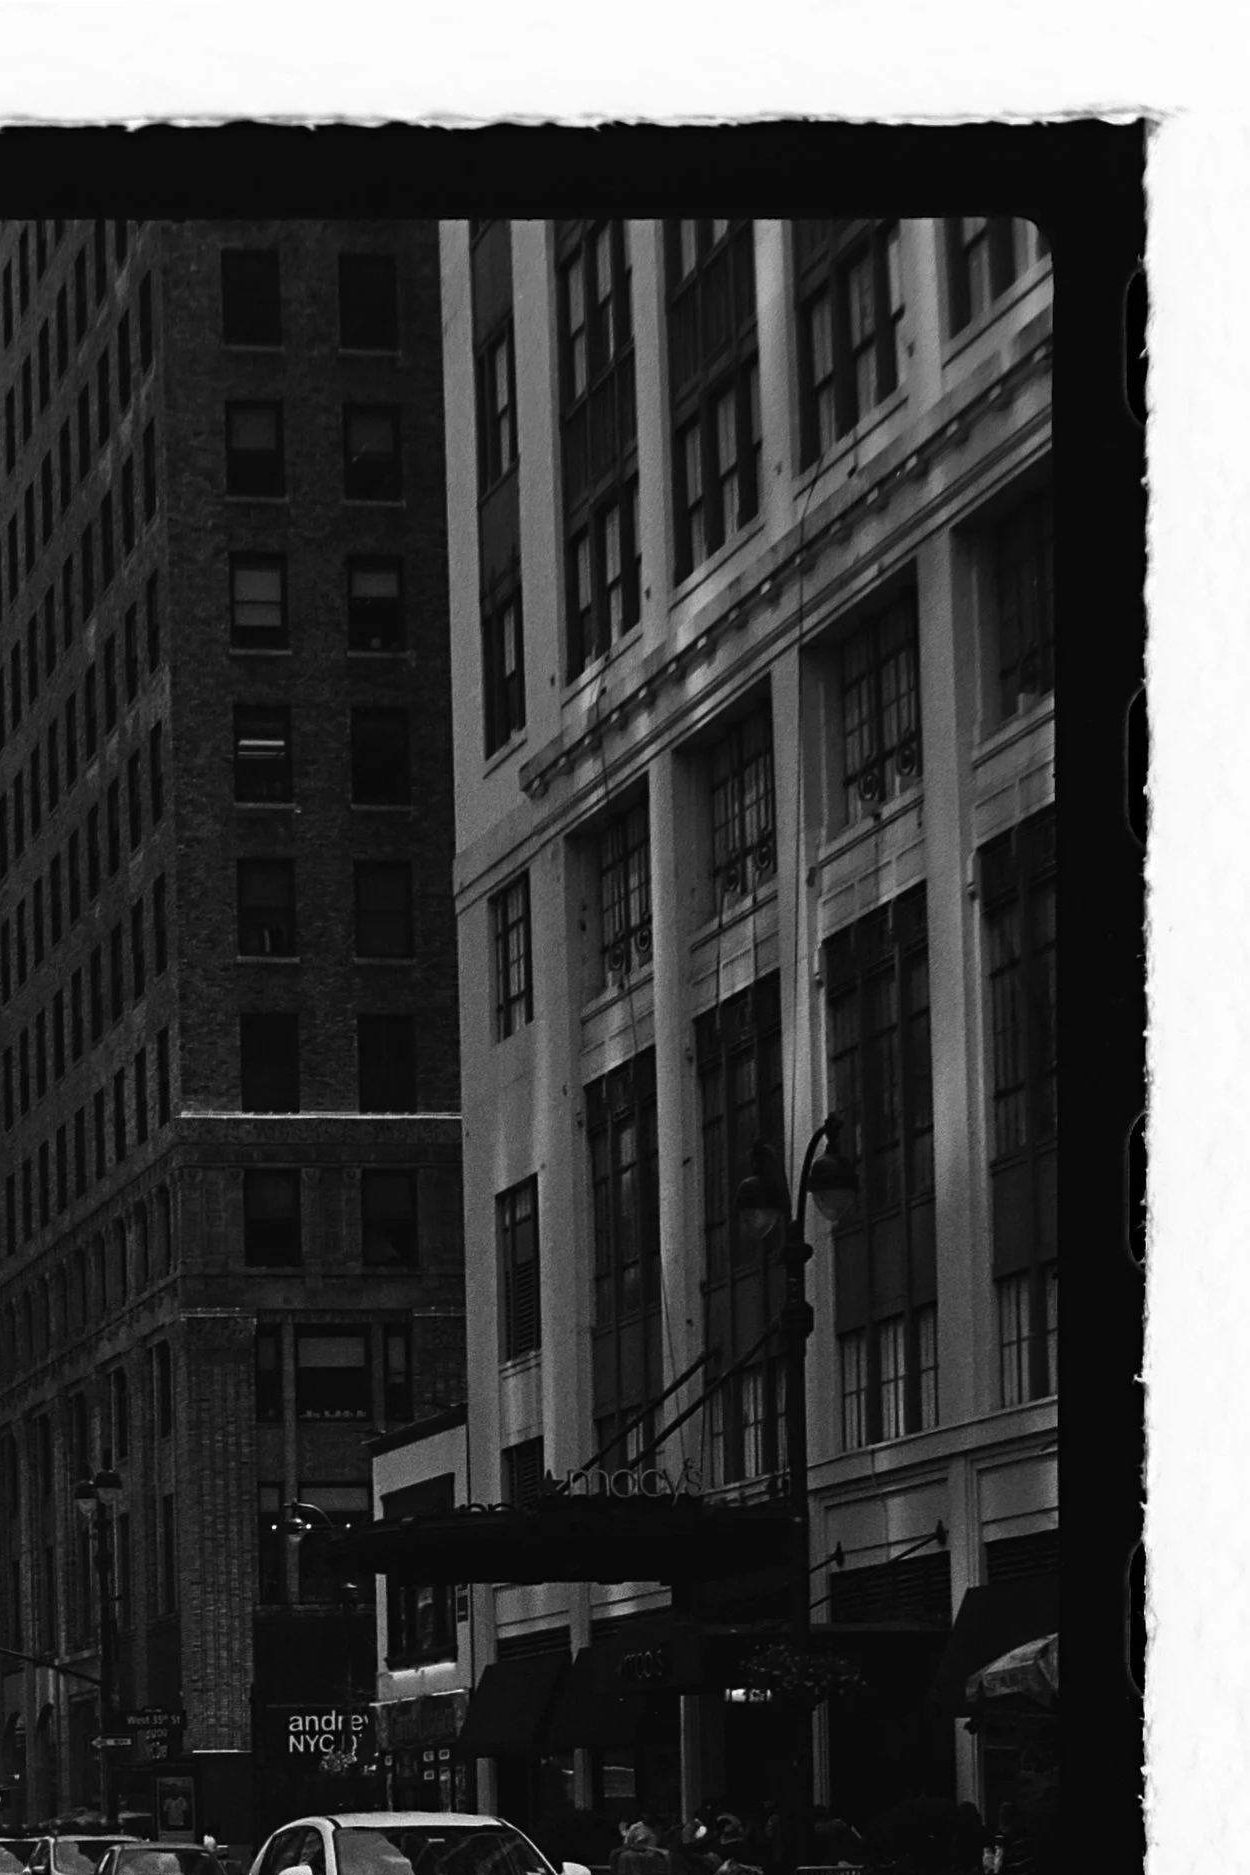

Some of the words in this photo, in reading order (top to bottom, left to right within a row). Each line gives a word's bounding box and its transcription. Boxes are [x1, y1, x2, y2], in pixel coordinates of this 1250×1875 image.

[567, 1457, 702, 1506] macy's
[126, 1715, 150, 1725] West
[289, 1710, 369, 1731] andre
